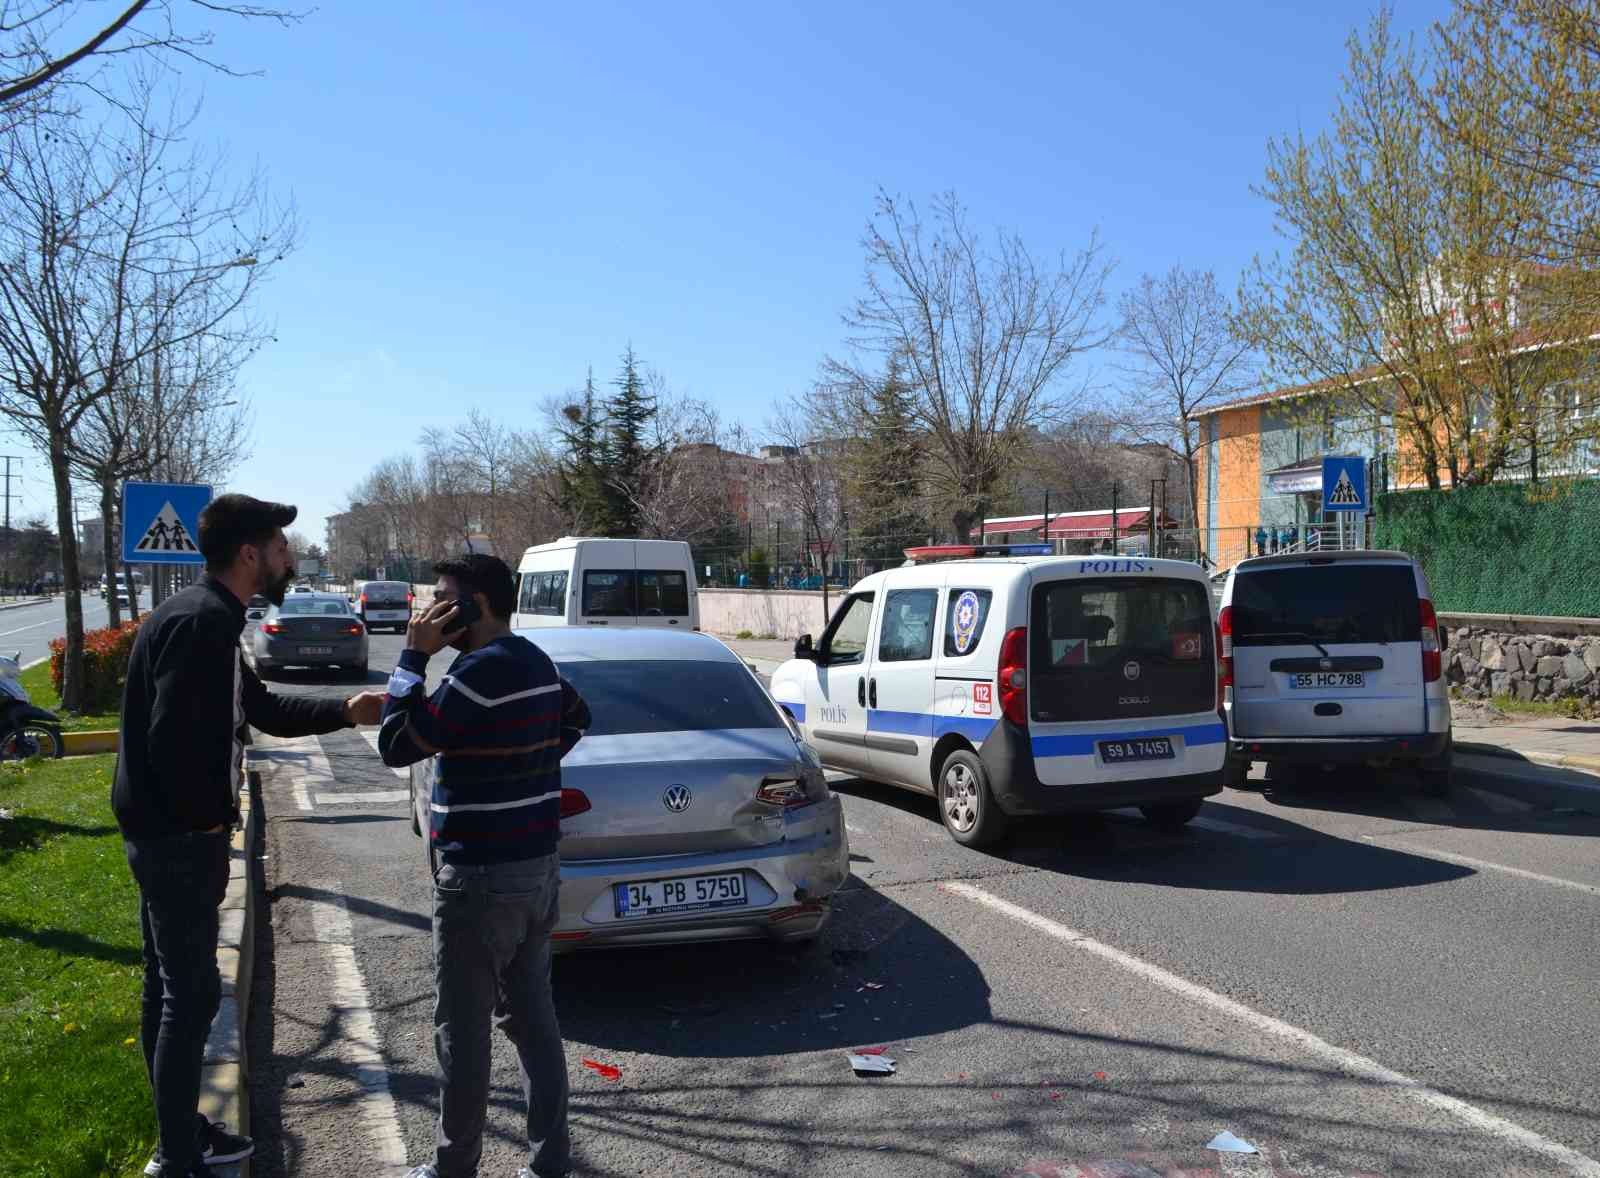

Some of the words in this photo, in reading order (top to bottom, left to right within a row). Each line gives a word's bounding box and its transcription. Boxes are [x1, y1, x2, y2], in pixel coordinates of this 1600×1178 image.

[1297, 673, 1313, 686] 55
[1317, 673, 1337, 686] HC
[1340, 673, 1361, 686] 788
[975, 686, 990, 702] 112
[1107, 744, 1124, 757] 59
[1126, 743, 1136, 756] A
[1137, 741, 1169, 756] 74157
[629, 885, 653, 908] 34
[663, 882, 686, 904] PB
[695, 876, 742, 901] 5750
